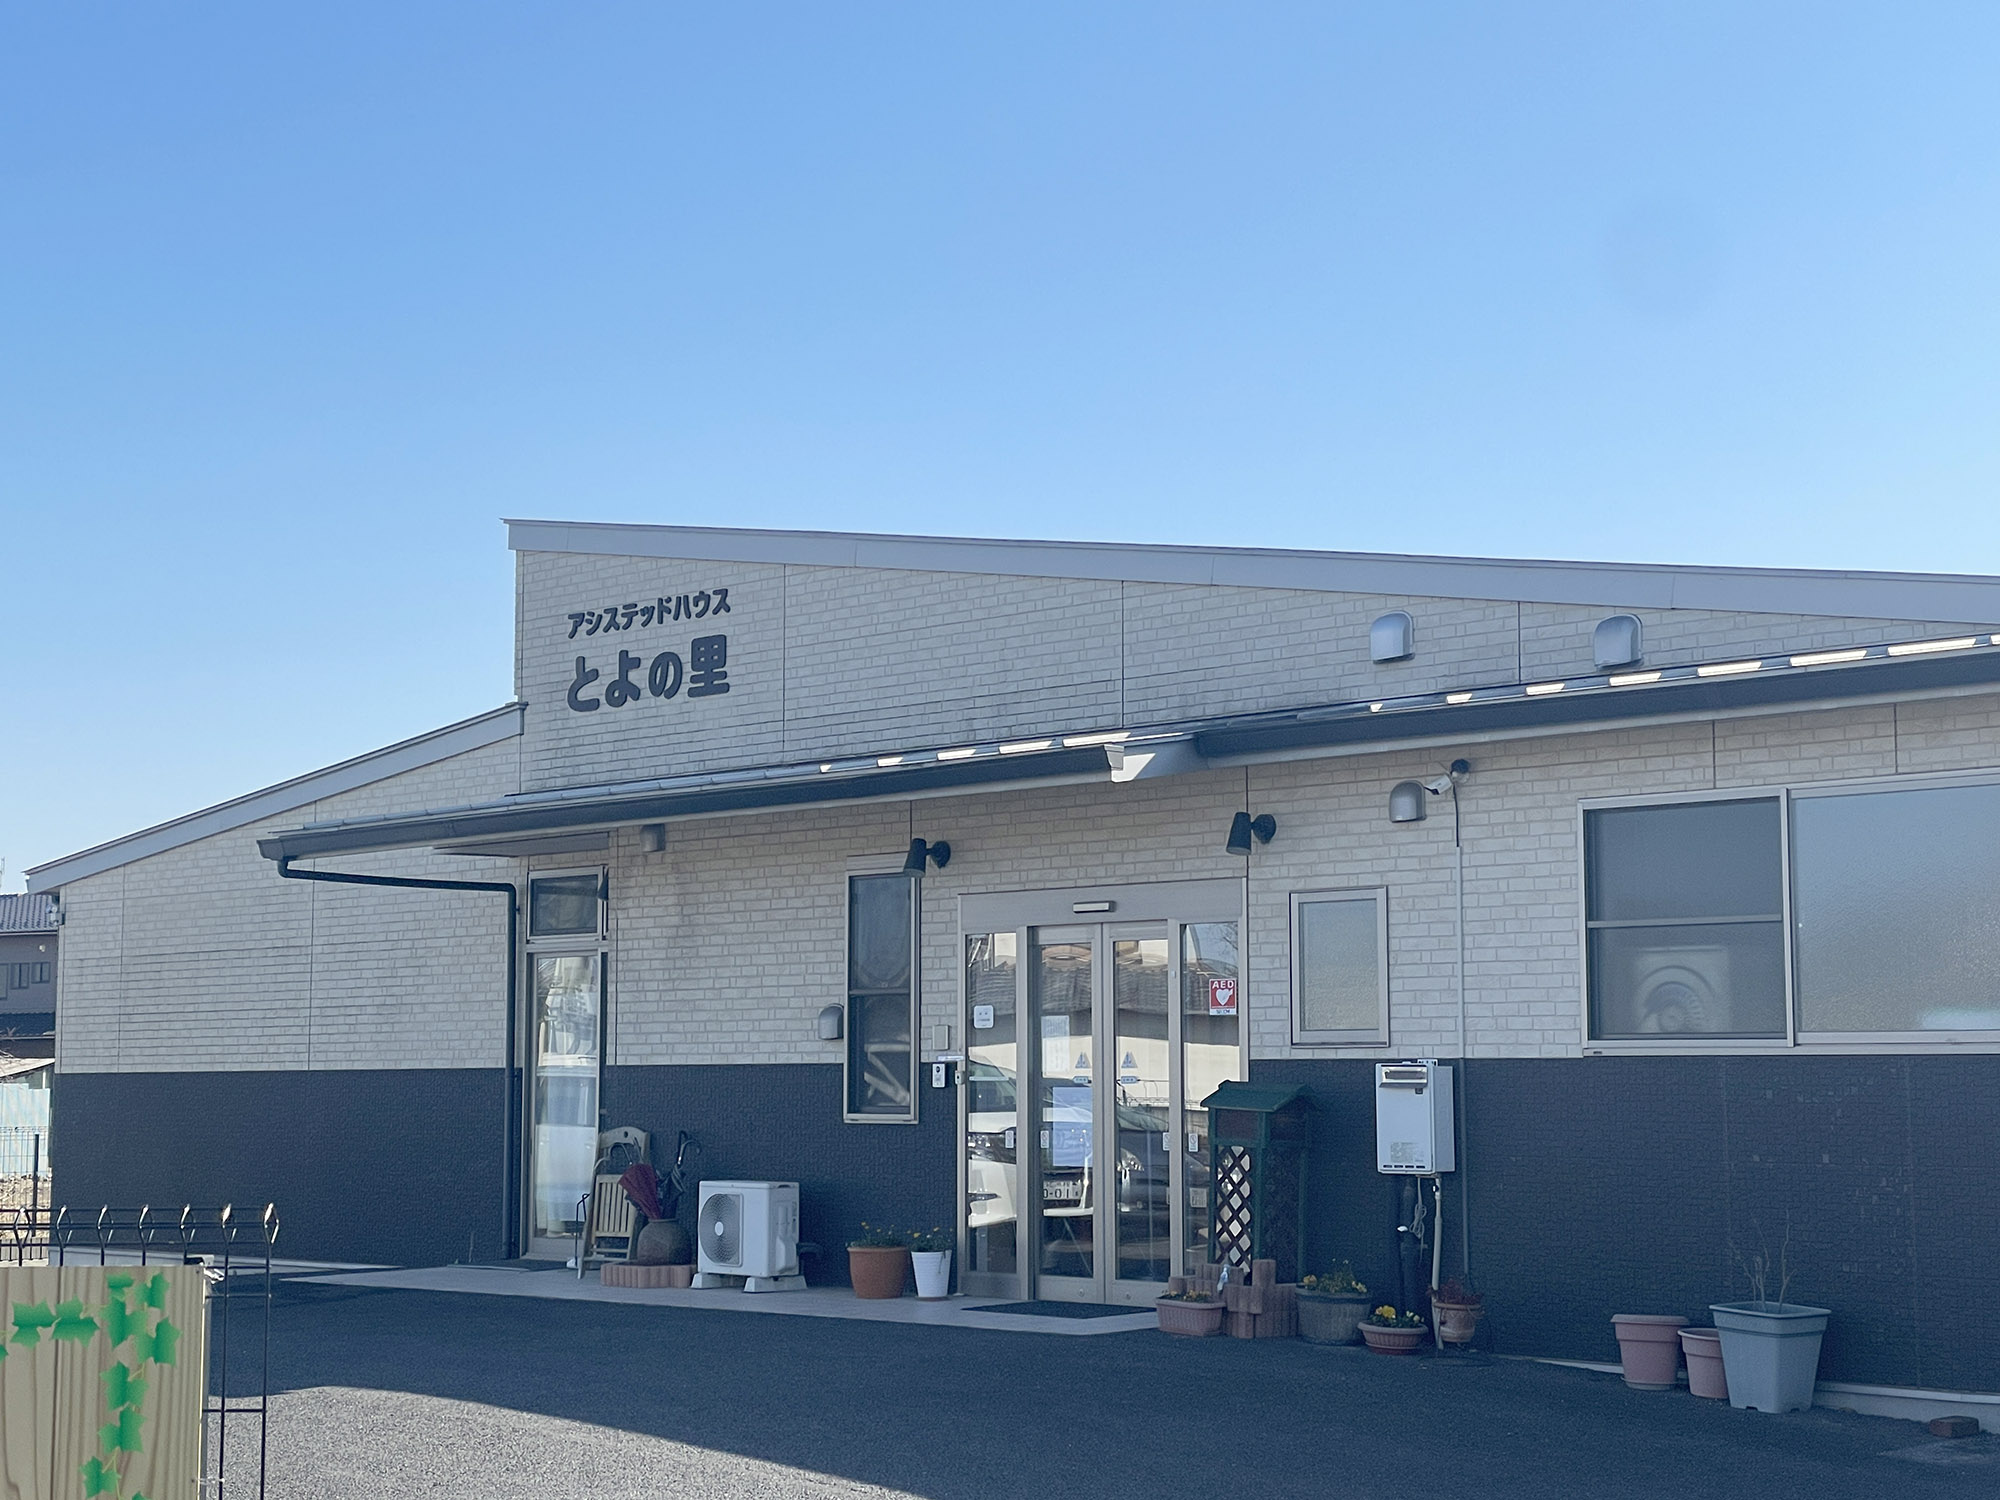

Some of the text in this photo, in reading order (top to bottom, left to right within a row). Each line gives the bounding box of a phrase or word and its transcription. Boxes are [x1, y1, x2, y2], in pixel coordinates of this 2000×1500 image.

[567, 588, 732, 639] アシステッドハウス
[566, 634, 731, 713] とよの里
[1211, 980, 1235, 989] AED
